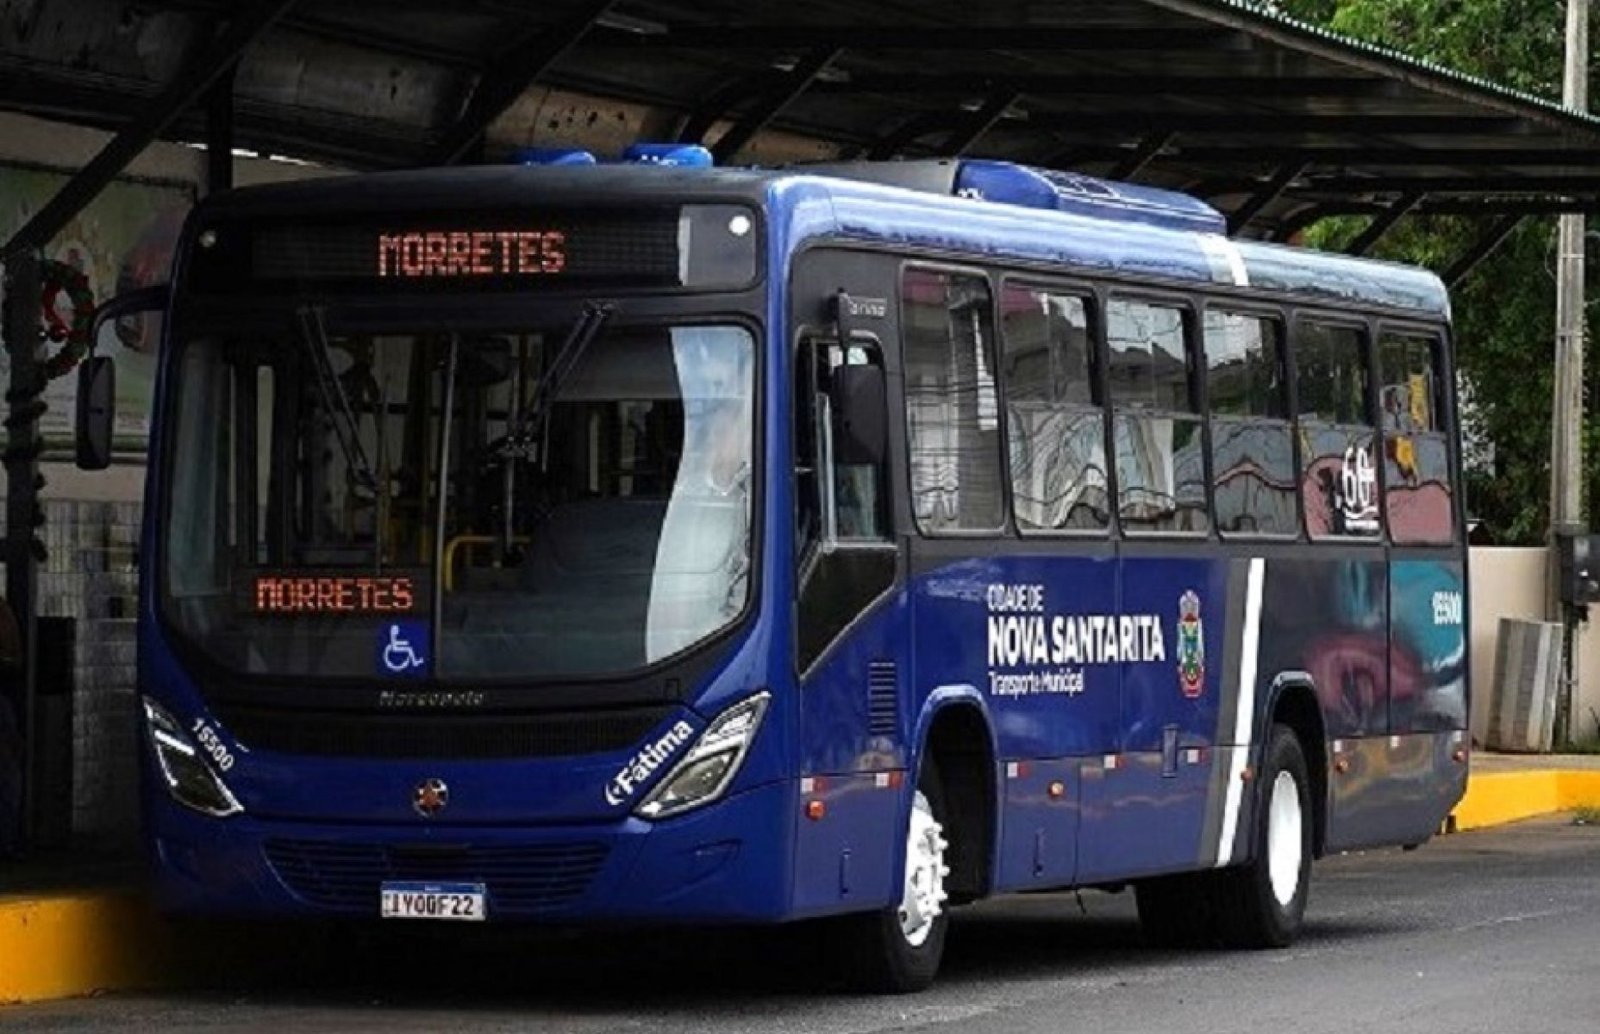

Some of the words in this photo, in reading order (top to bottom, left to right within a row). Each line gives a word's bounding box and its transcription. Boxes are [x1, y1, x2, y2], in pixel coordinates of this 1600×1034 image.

[379, 231, 565, 277] MORRETES
[256, 578, 413, 611] MORRETES
[987, 584, 1027, 611] CIDADE
[1028, 584, 1044, 611] DE
[987, 616, 1050, 666] NOVA
[988, 671, 1040, 700] Transporte
[1041, 668, 1084, 697] Municipal
[614, 720, 694, 795] Fátima
